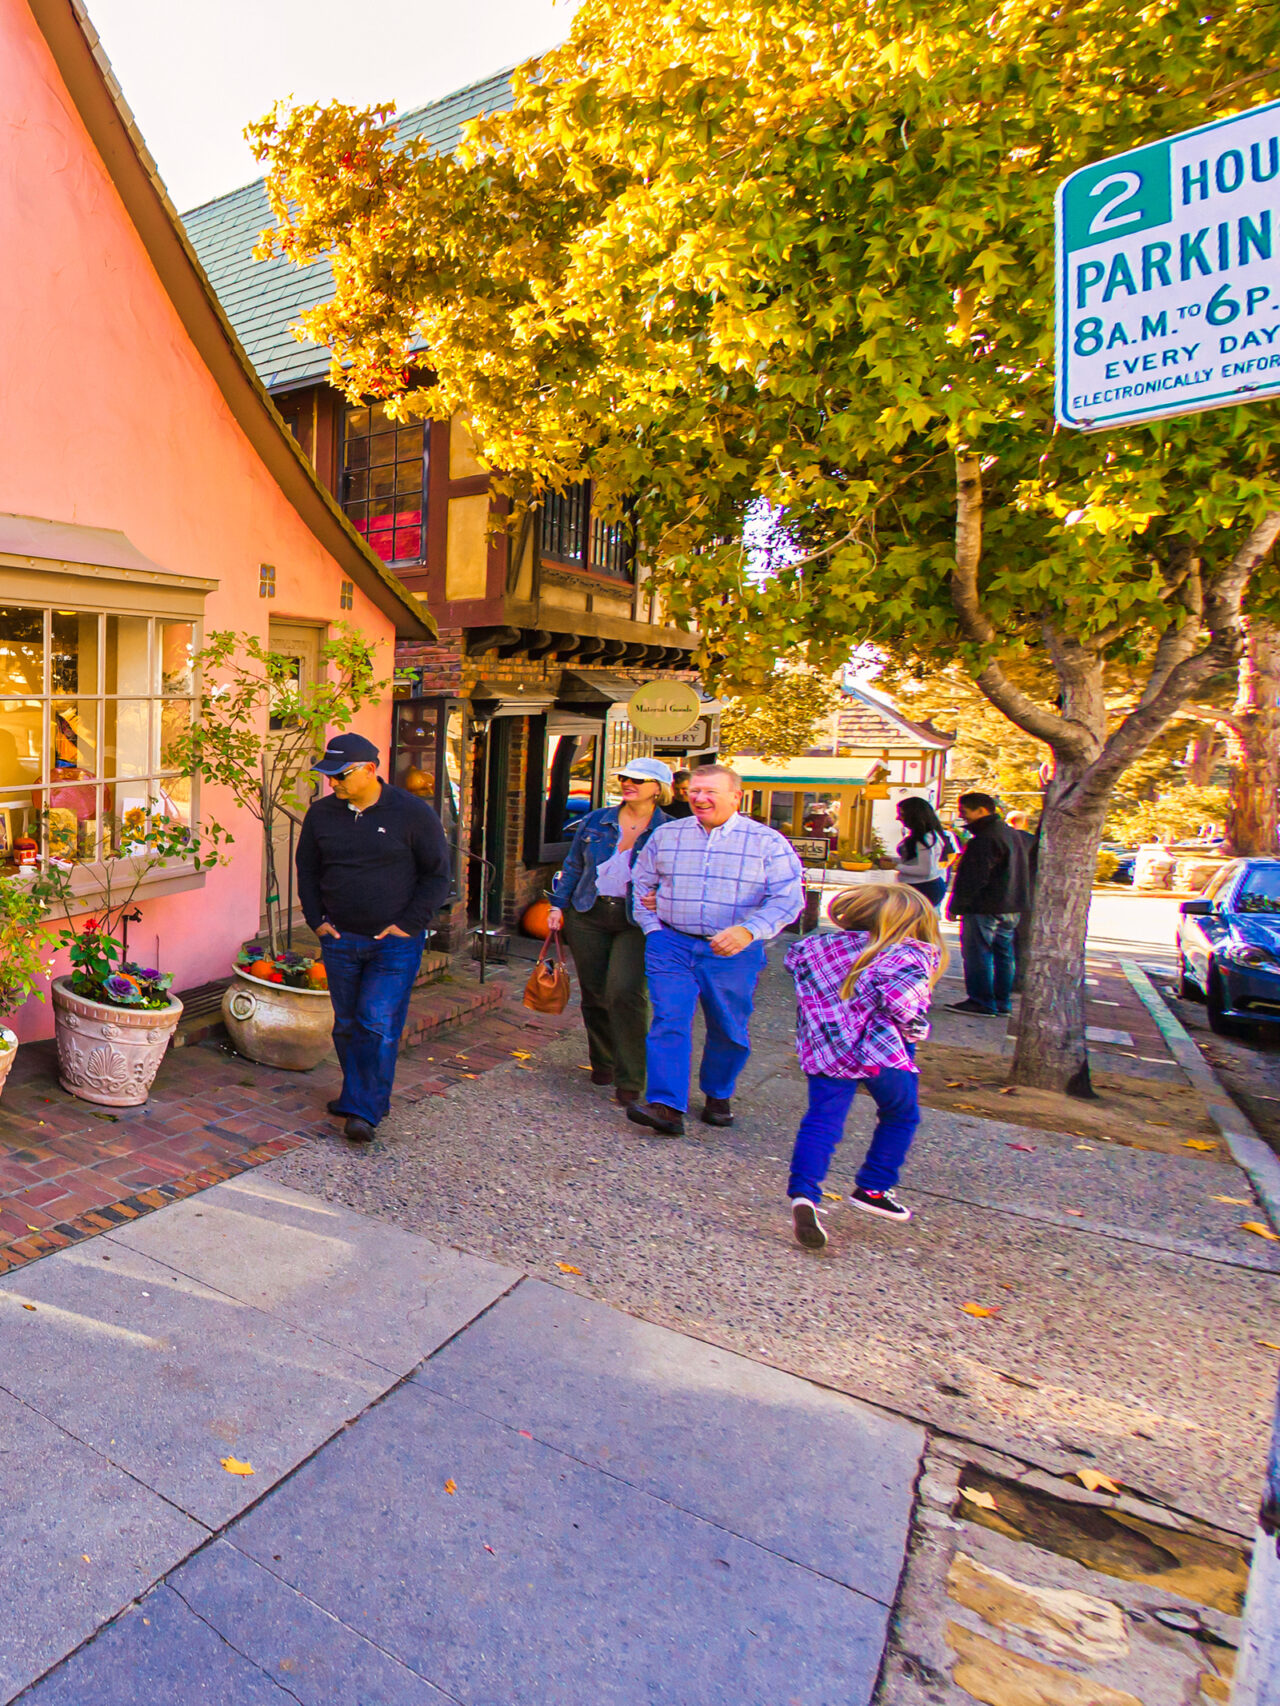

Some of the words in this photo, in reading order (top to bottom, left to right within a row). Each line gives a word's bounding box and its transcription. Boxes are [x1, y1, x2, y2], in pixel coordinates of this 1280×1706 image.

[1088, 171, 1142, 235] 2
[1181, 136, 1279, 206] HOU
[1076, 209, 1273, 310] PARKIN
[1176, 303, 1201, 319] TO
[1105, 342, 1201, 380] EVERY
[1219, 324, 1280, 354] DAY
[1072, 367, 1214, 409] ELECTRONICALLY
[1221, 354, 1280, 378] ENFOR
